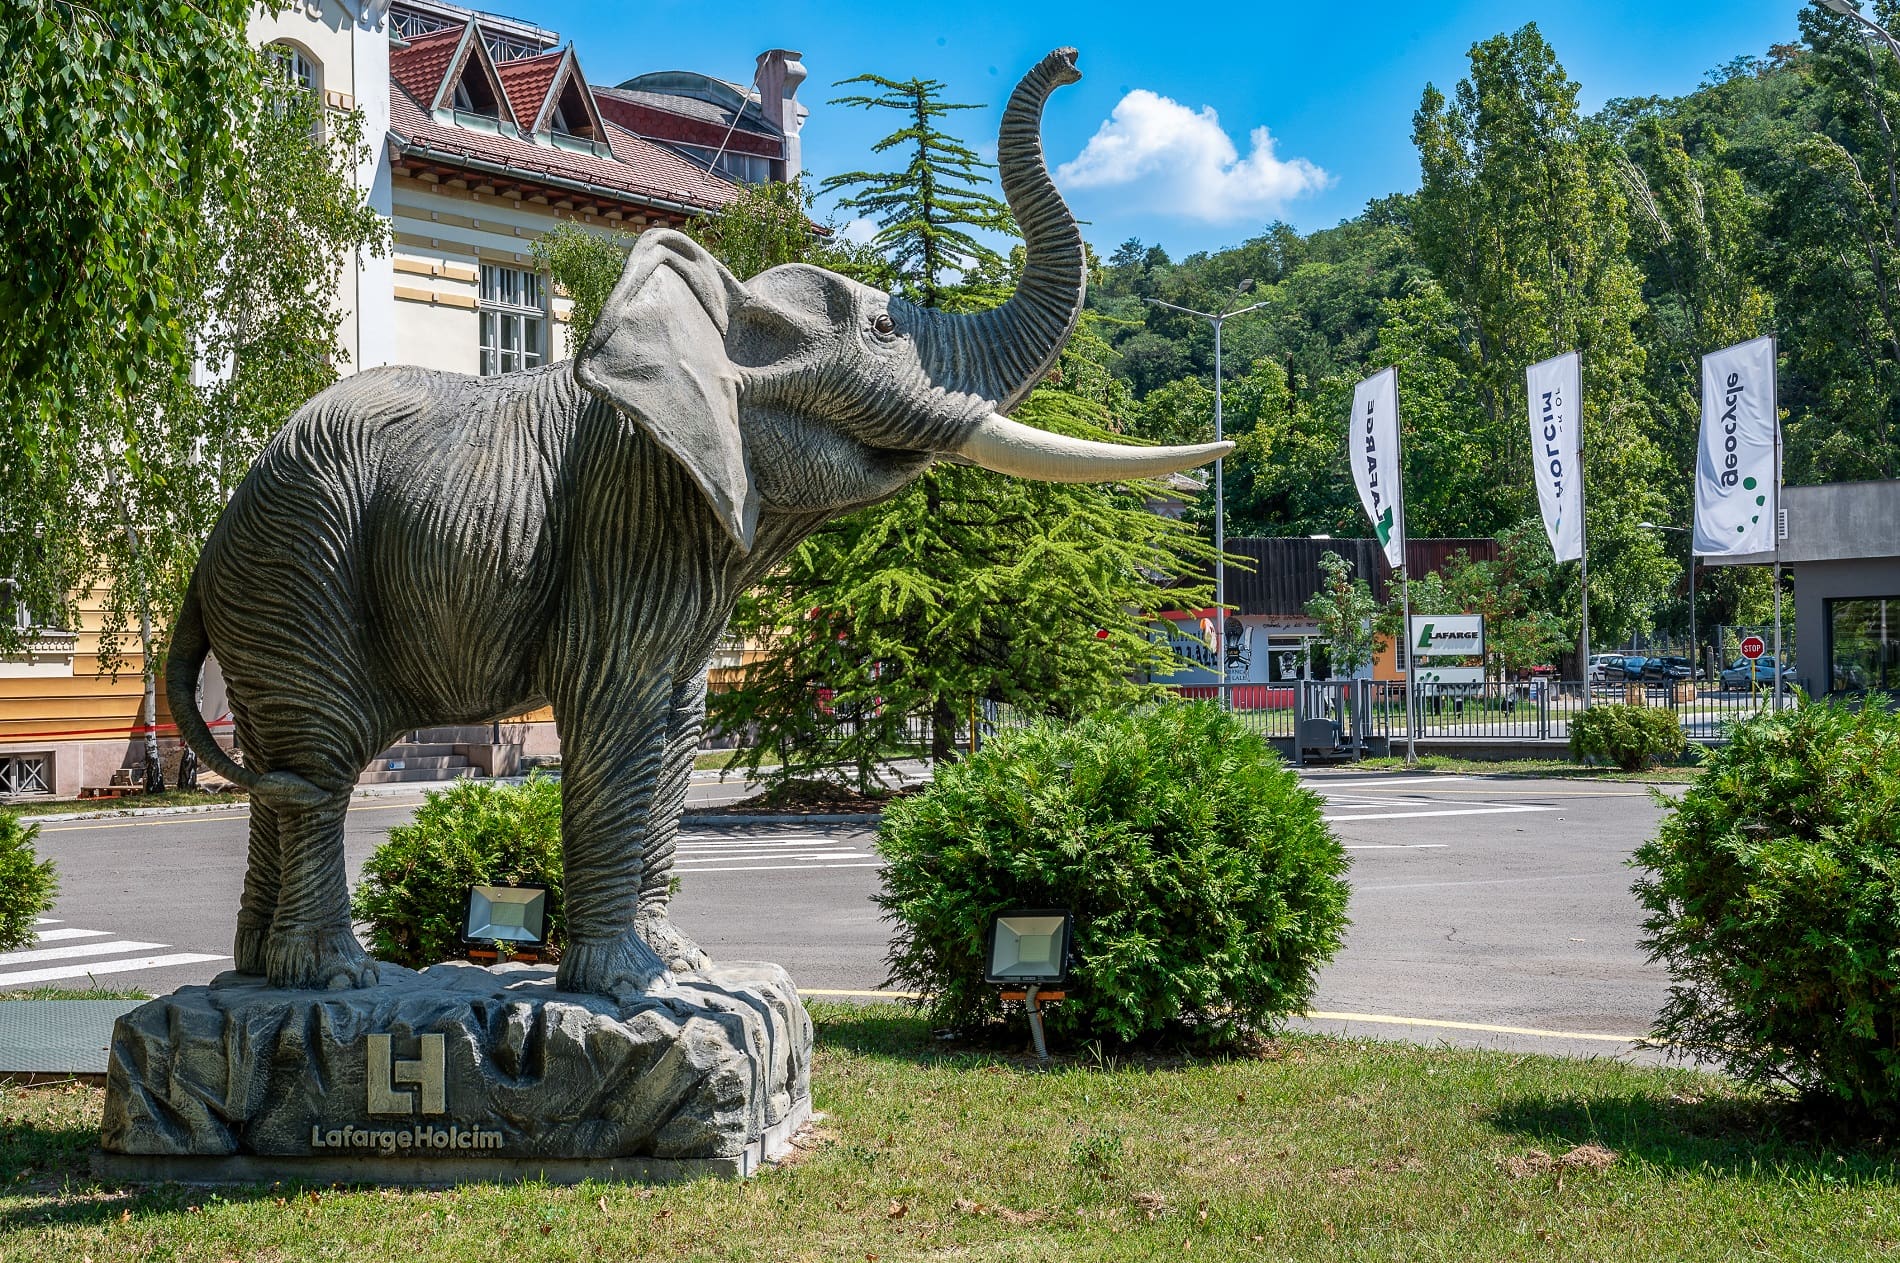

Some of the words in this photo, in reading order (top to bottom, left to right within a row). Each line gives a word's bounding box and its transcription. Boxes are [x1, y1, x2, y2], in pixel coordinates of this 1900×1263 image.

[1430, 631, 1479, 639] LAFARGE
[1743, 644, 1762, 653] STOP
[311, 1125, 505, 1154] LafargeHolcim
